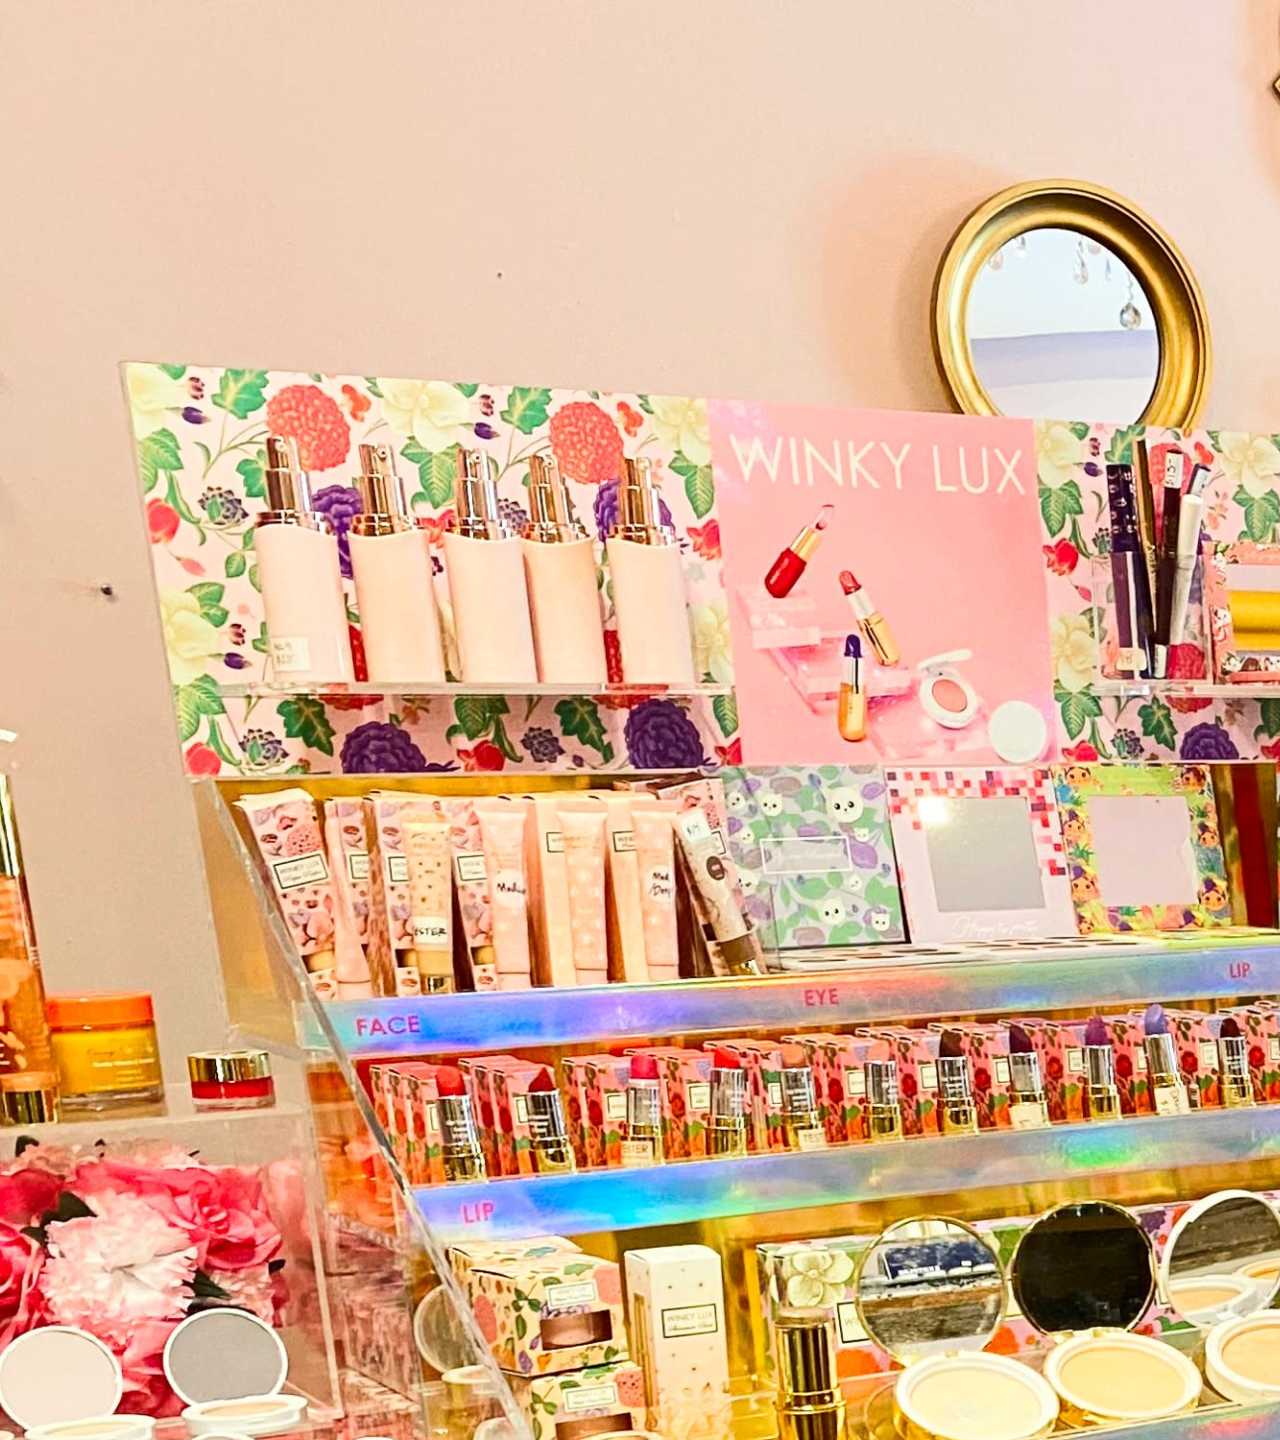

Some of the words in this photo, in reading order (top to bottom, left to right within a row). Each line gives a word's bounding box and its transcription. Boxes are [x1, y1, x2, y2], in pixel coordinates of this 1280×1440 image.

[729, 433, 912, 490] WINKY
[931, 445, 1026, 495] LUX
[1229, 961, 1251, 979] LIP
[803, 988, 839, 1007] EYE
[356, 1015, 421, 1038] FACE
[462, 1202, 495, 1224] LIP
